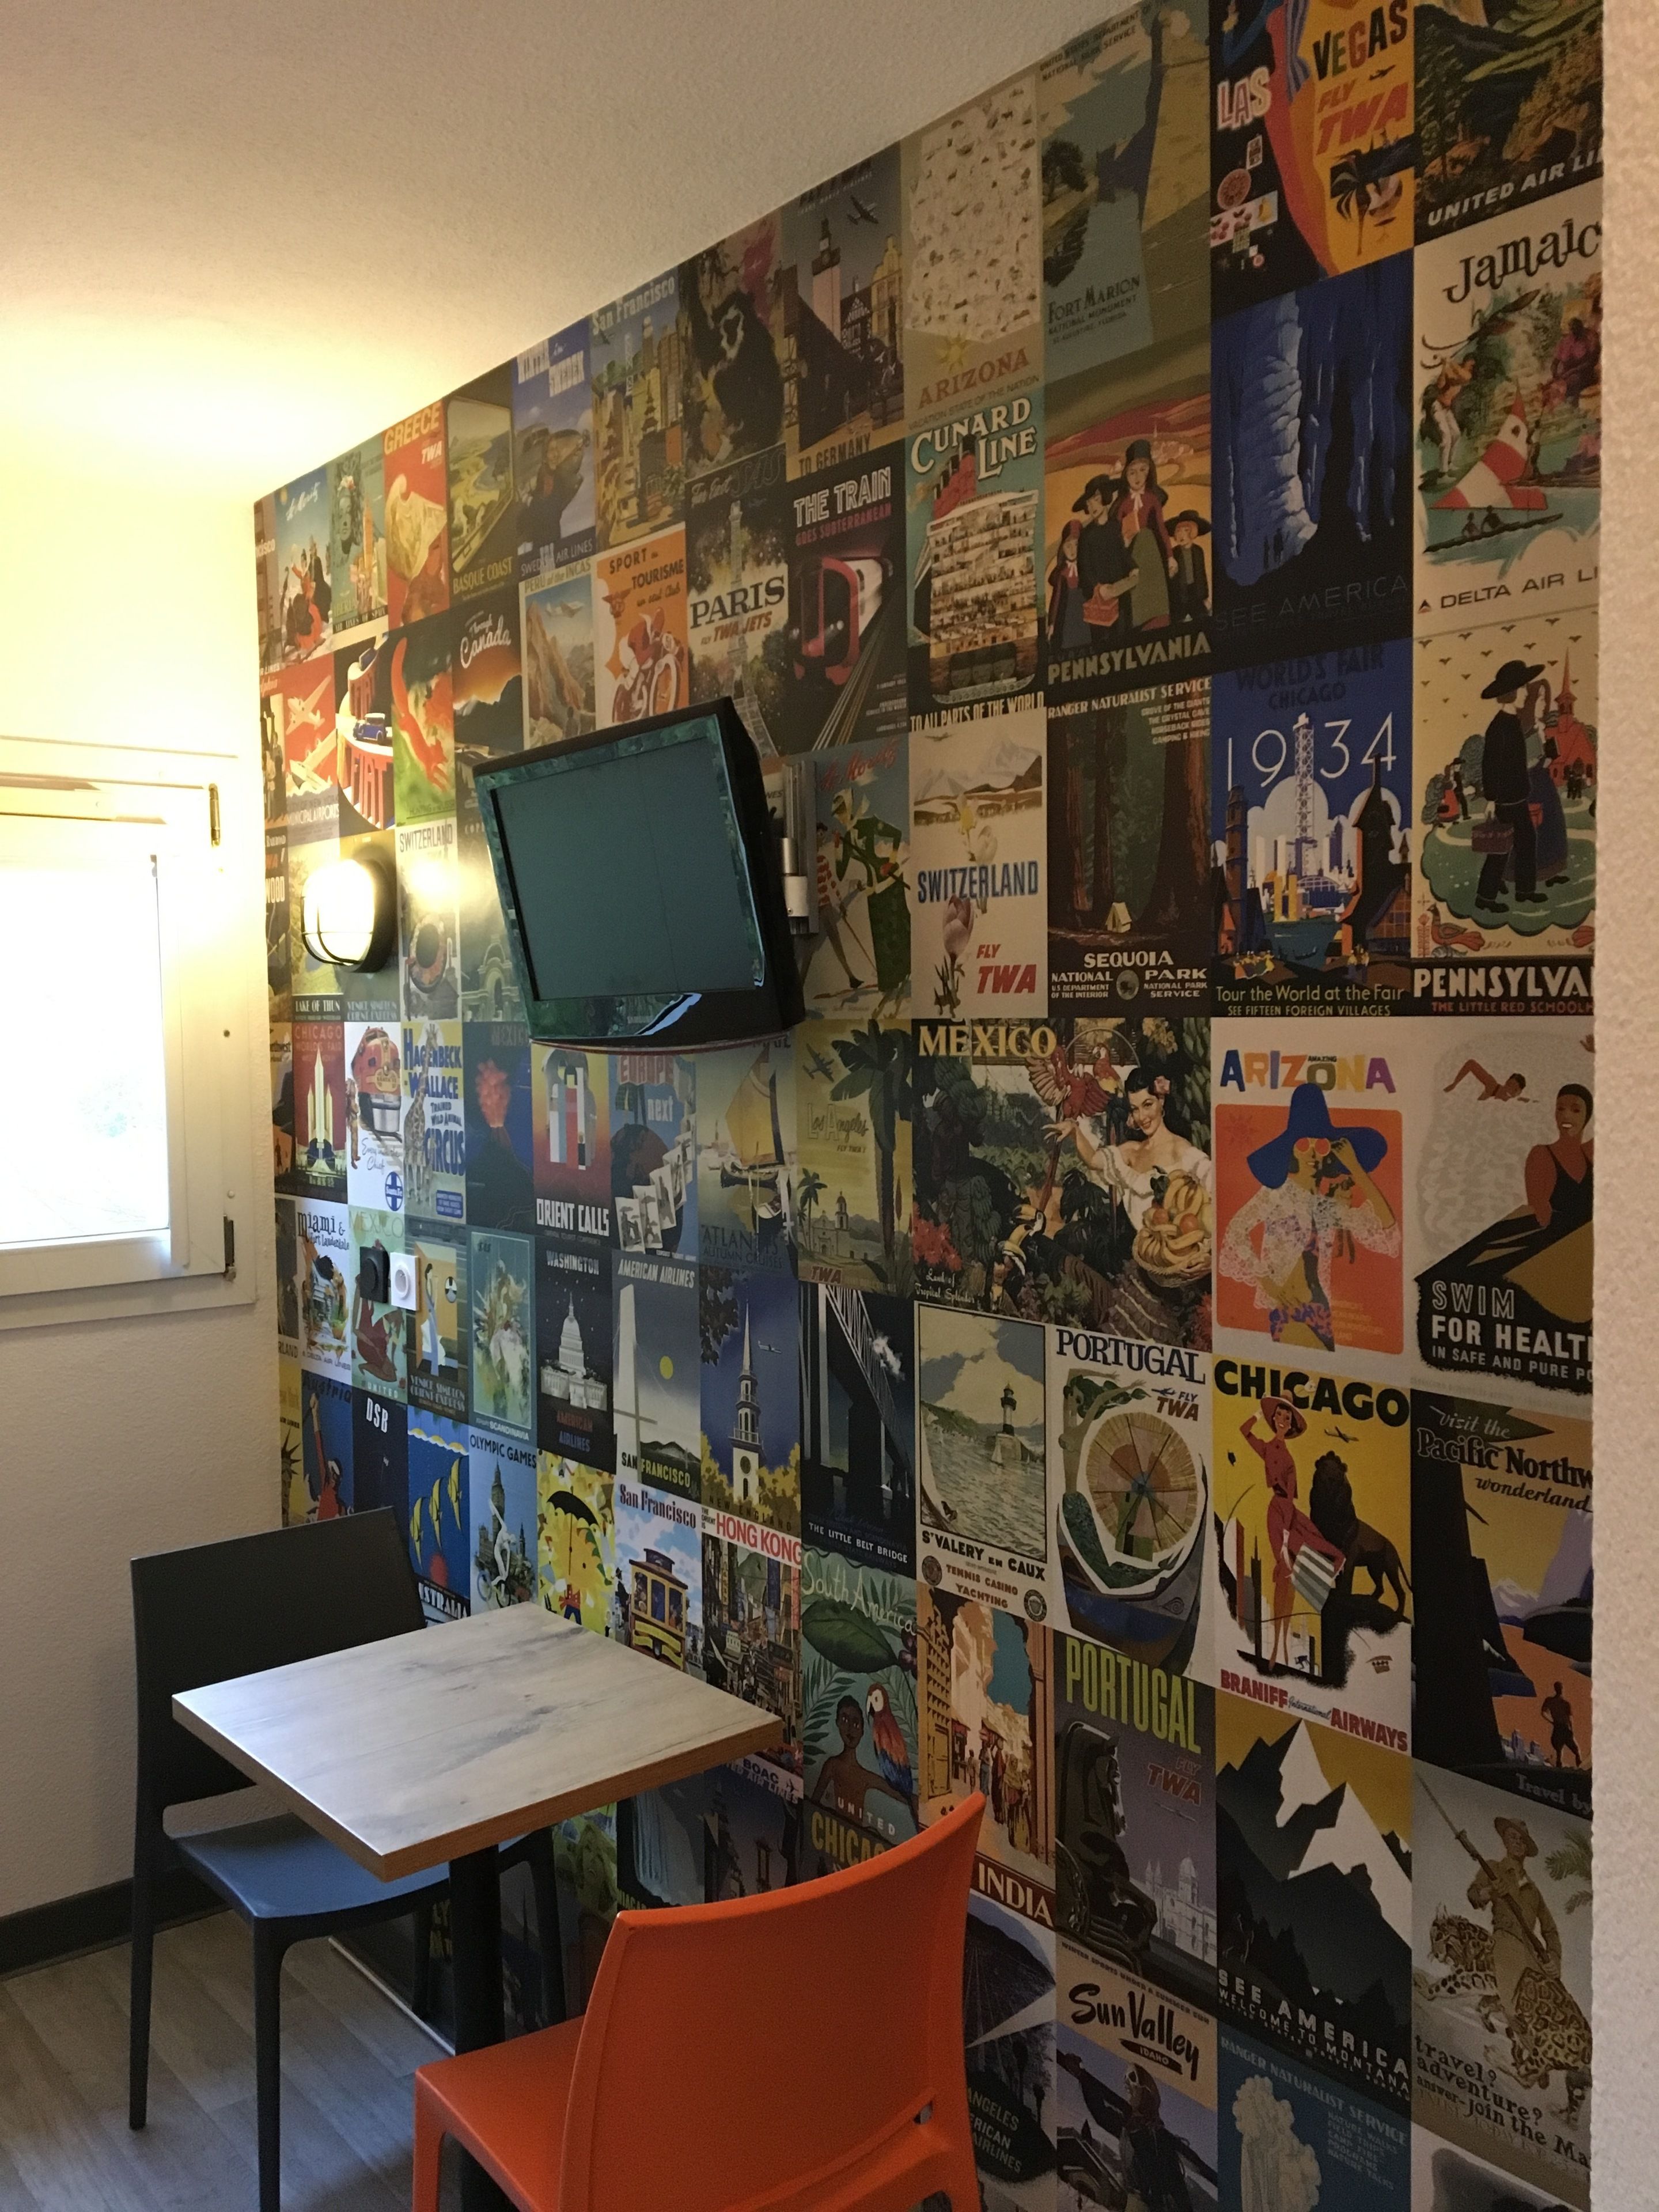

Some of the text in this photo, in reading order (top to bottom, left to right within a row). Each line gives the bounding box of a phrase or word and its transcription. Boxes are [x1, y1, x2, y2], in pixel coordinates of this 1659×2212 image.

[1313, 0, 1408, 81] VEGAS
[1217, 66, 1272, 130] LAS
[1318, 79, 1355, 113] FLY
[1316, 82, 1408, 156] TWA
[1429, 162, 1565, 227] UNITED AIR
[591, 275, 675, 335] San Francisco
[918, 347, 1029, 410] ARIZONA
[384, 403, 441, 456] GREECE
[911, 397, 1032, 474] CUNARD
[421, 440, 443, 465] TWA
[799, 433, 871, 476] TO GERMANY
[977, 426, 1037, 480] LINE
[793, 488, 830, 528] THE
[833, 465, 892, 514] TRAIN
[555, 537, 593, 564] AIR LINES
[609, 547, 647, 575] SPORT
[453, 567, 485, 595] BASQUE
[487, 556, 513, 582] COAST
[631, 558, 684, 590] TOURISME
[1440, 572, 1565, 610] DELTA AIR
[690, 576, 785, 629] PARIS
[1215, 575, 1409, 631] SEE AMERICA
[460, 614, 512, 669] Canada
[714, 611, 772, 643] TWA JETS
[1048, 631, 1211, 685] PENNSYLVANIA
[910, 715, 923, 733] TO
[941, 705, 971, 728] PARTS
[973, 702, 986, 721] OF
[987, 698, 1005, 718] THE
[1006, 691, 1046, 714] WORLD
[1048, 676, 1212, 719] RANGER NATURALIST SERVICE
[1267, 680, 1346, 710] CHICAGO
[1227, 712, 1397, 793] 1934
[400, 823, 453, 853] SWITZERLAND
[918, 860, 1039, 904] SWITZERLAND
[976, 944, 1001, 959] FLY
[1084, 950, 1175, 968] SEQUOIA
[976, 964, 1037, 995] TWA
[1051, 968, 1208, 983] NATIONAL PARK
[1062, 983, 1110, 991] DEPARTMENT
[1143, 981, 1209, 990] NATIONAL PARK
[1215, 983, 1406, 1001] Tour the World at the Fair
[295, 999, 341, 1012] LAKE OF THUN
[1150, 989, 1201, 998] SERVICE
[1228, 1005, 1391, 1017] SEE FIFTEEN FOREIGN VILLAGES
[1431, 1001, 1525, 1013] THE LITTLE RED
[294, 1025, 343, 1040] CHICAGO
[919, 1025, 1057, 1058] MEXICO
[620, 1055, 675, 1084] EUROPE
[1220, 1050, 1397, 1094] ARIZONA
[647, 1095, 673, 1122] next
[827, 1103, 869, 1143] Angeles
[425, 1128, 465, 1176] CIRCUS
[298, 1212, 346, 1243] miami &
[536, 1198, 610, 1237] ORIENT CALLS
[546, 1249, 600, 1275] WASHINGTON
[617, 1259, 695, 1289] AMERICAN AIRLINES
[811, 1266, 842, 1284] TWA
[926, 1268, 956, 1288] Land of
[1432, 1280, 1516, 1320] SWIM
[1432, 1315, 1482, 1346] FOR
[1056, 1328, 1206, 1385] PORTUGAL
[1432, 1346, 1569, 1378] IN SAFE AND PURE
[368, 1382, 399, 1399] UNITED
[1177, 1391, 1198, 1404] FLY
[1214, 1359, 1411, 1428] CHICAGO
[366, 1397, 389, 1433] DSB
[556, 1409, 593, 1433] AMERICAN
[1156, 1395, 1199, 1422] TWA
[490, 1421, 529, 1441] SCANDINAVIA
[558, 1431, 590, 1453] AIRLINES
[1484, 1418, 1512, 1440] the
[470, 1434, 537, 1469] OLYMPIC GAMES
[1416, 1427, 1499, 1471] Pacific
[641, 1460, 691, 1488] FRANCISCO
[619, 1483, 696, 1529] San Francisco
[1475, 1476, 1593, 1514] wonderland
[739, 1502, 793, 1533] ENGLAND
[716, 1513, 758, 1548] HONG
[760, 1528, 802, 1565] KONG
[808, 1522, 908, 1564] THE LITTLE BELT BRIDGE
[935, 1534, 985, 1560] VALERY
[1008, 1558, 1046, 1582] CAUX
[801, 1551, 916, 1637] South America
[946, 1564, 981, 1584] TENNIS
[984, 1577, 1018, 1596] CASINO
[955, 1583, 1009, 1609] YACHTING
[1066, 1635, 1203, 1755] PORTUGAL
[1220, 1668, 1408, 1753] BRANIFF AIRWAYS
[743, 1758, 780, 1785] BOAC
[1175, 1757, 1202, 1777] FLY
[1147, 1762, 1203, 1808] TWA
[1515, 1772, 1566, 1805] Travel
[837, 1796, 896, 1836] UNITED
[978, 1862, 1056, 1927] INDIA
[1069, 1982, 1126, 2028] Sun
[1128, 1990, 1200, 2082] Valley
[1218, 1968, 1262, 2005] SEE
[1278, 1999, 1409, 2080] AMERICA
[1219, 1988, 1290, 2034] WELCOME
[1300, 2027, 1317, 2045] TO
[1326, 2042, 1410, 2093] MONTANA
[1139, 2046, 1170, 2066] IDAHO
[1415, 2035, 1498, 2088] travel?
[1221, 2037, 1407, 2147] RANGER NATURALIST SERVICE
[1416, 2056, 1543, 2126] adventure?
[1511, 2115, 1548, 2146] the
